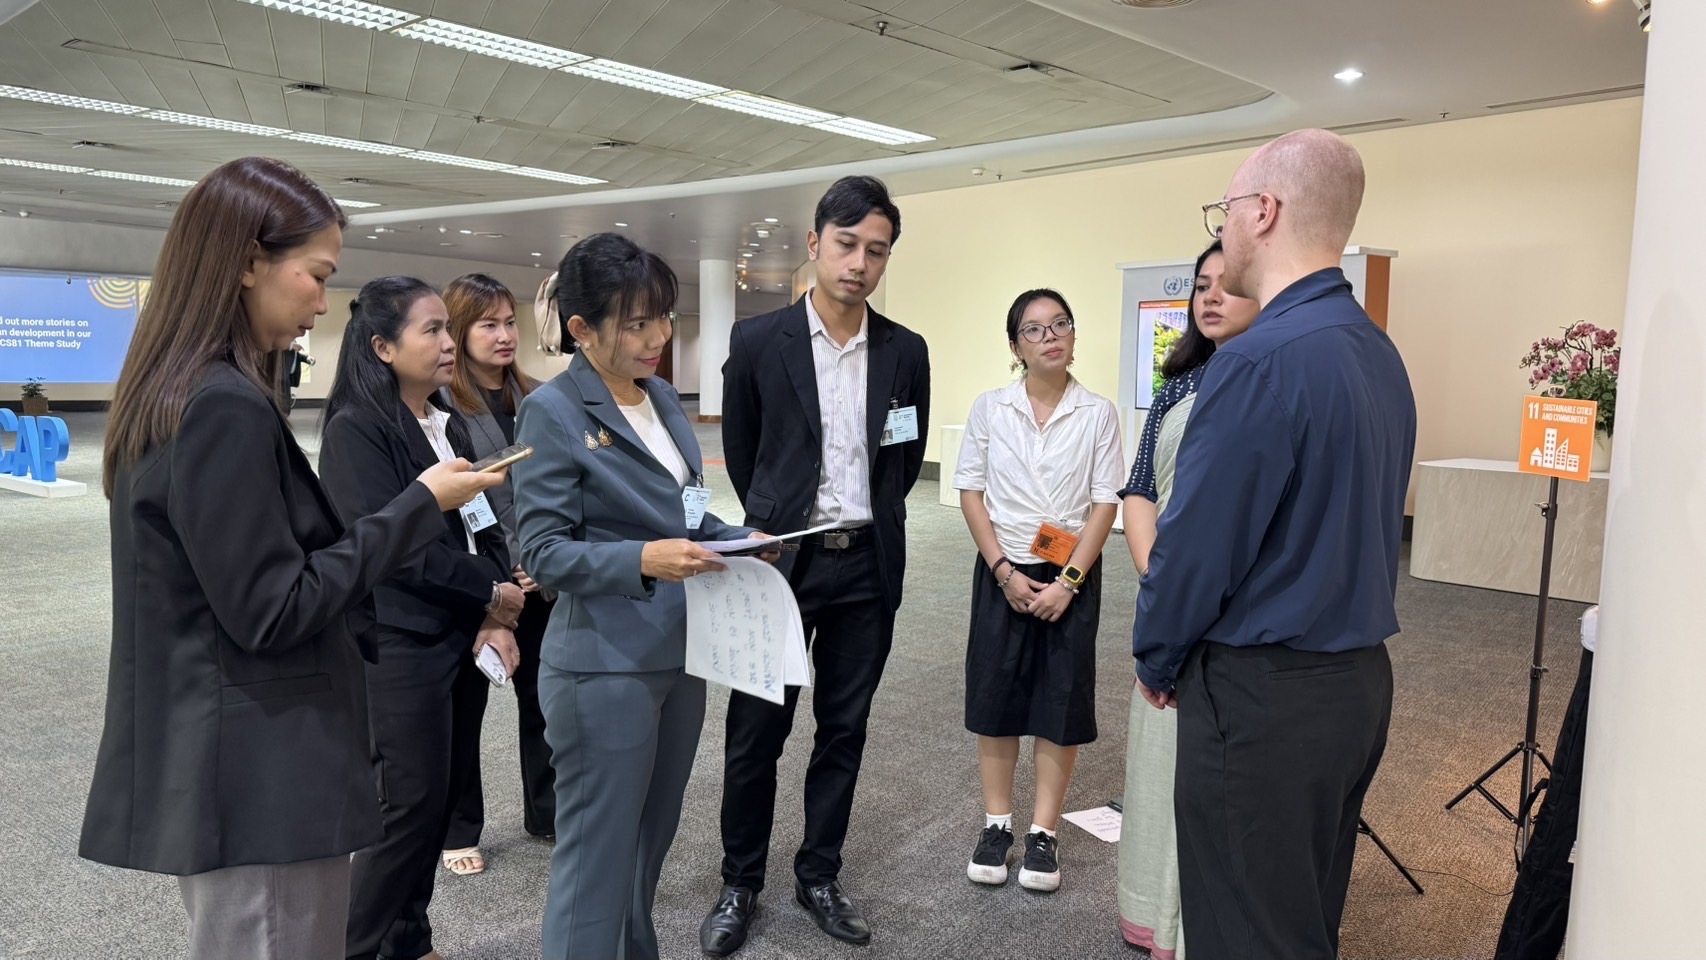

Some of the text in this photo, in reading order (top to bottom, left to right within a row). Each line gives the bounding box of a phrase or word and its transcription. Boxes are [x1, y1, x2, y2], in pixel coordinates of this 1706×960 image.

[5, 317, 20, 326] out
[45, 317, 76, 327] stories
[9, 327, 65, 339] development
[66, 329, 75, 337] in
[76, 330, 92, 338] our
[24, 339, 55, 348] Theme
[56, 339, 81, 350] Study
[1528, 402, 1539, 419] 11
[1542, 403, 1593, 416] SUSTAINABLE CITIES
[1541, 412, 1588, 424] AND COMMUNITIES
